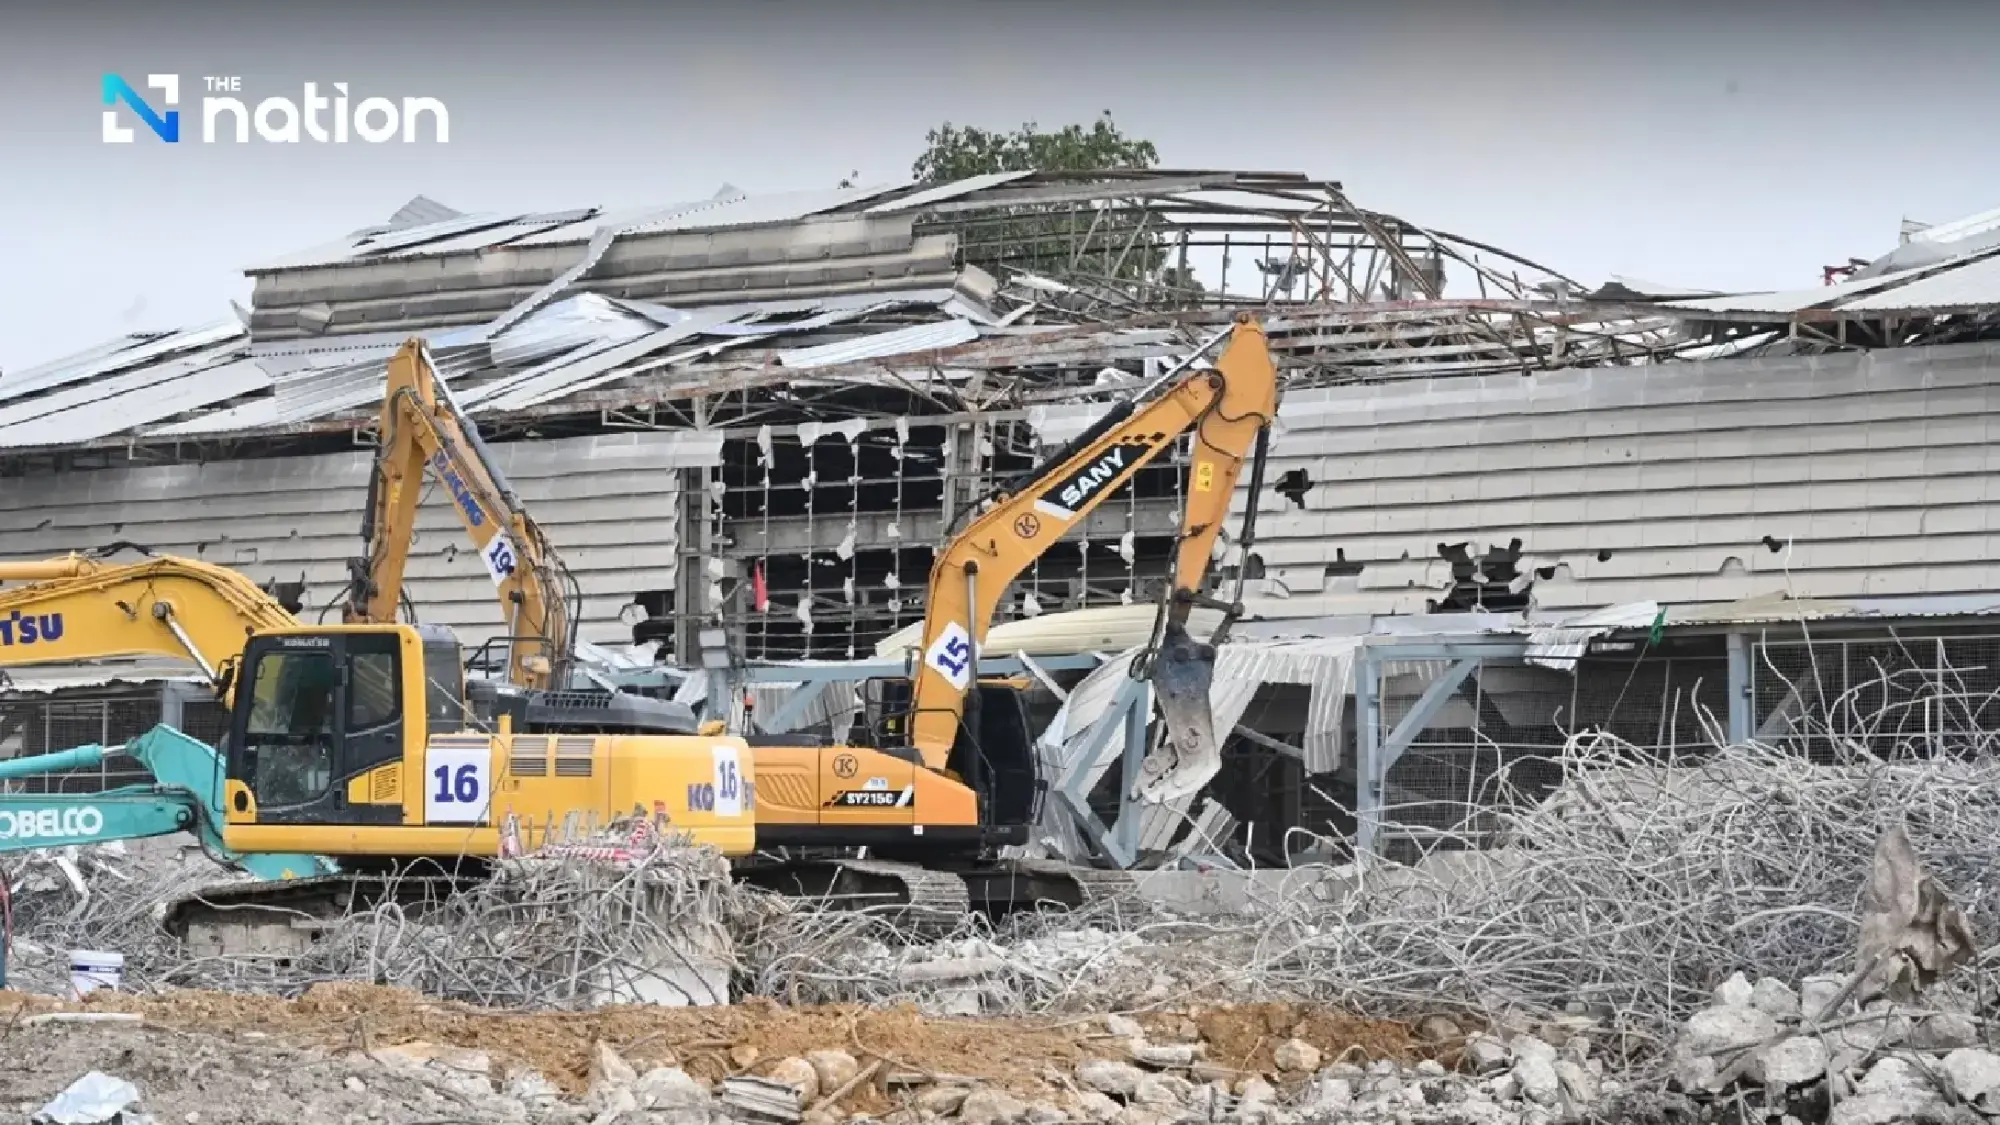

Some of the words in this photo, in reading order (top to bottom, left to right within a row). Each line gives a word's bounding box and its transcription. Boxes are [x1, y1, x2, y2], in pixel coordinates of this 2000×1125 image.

[1061, 447, 1125, 508] SANY
[937, 635, 970, 677] 15
[434, 764, 479, 803] 16
[719, 760, 737, 800] 16
[847, 793, 894, 804] SY215C
